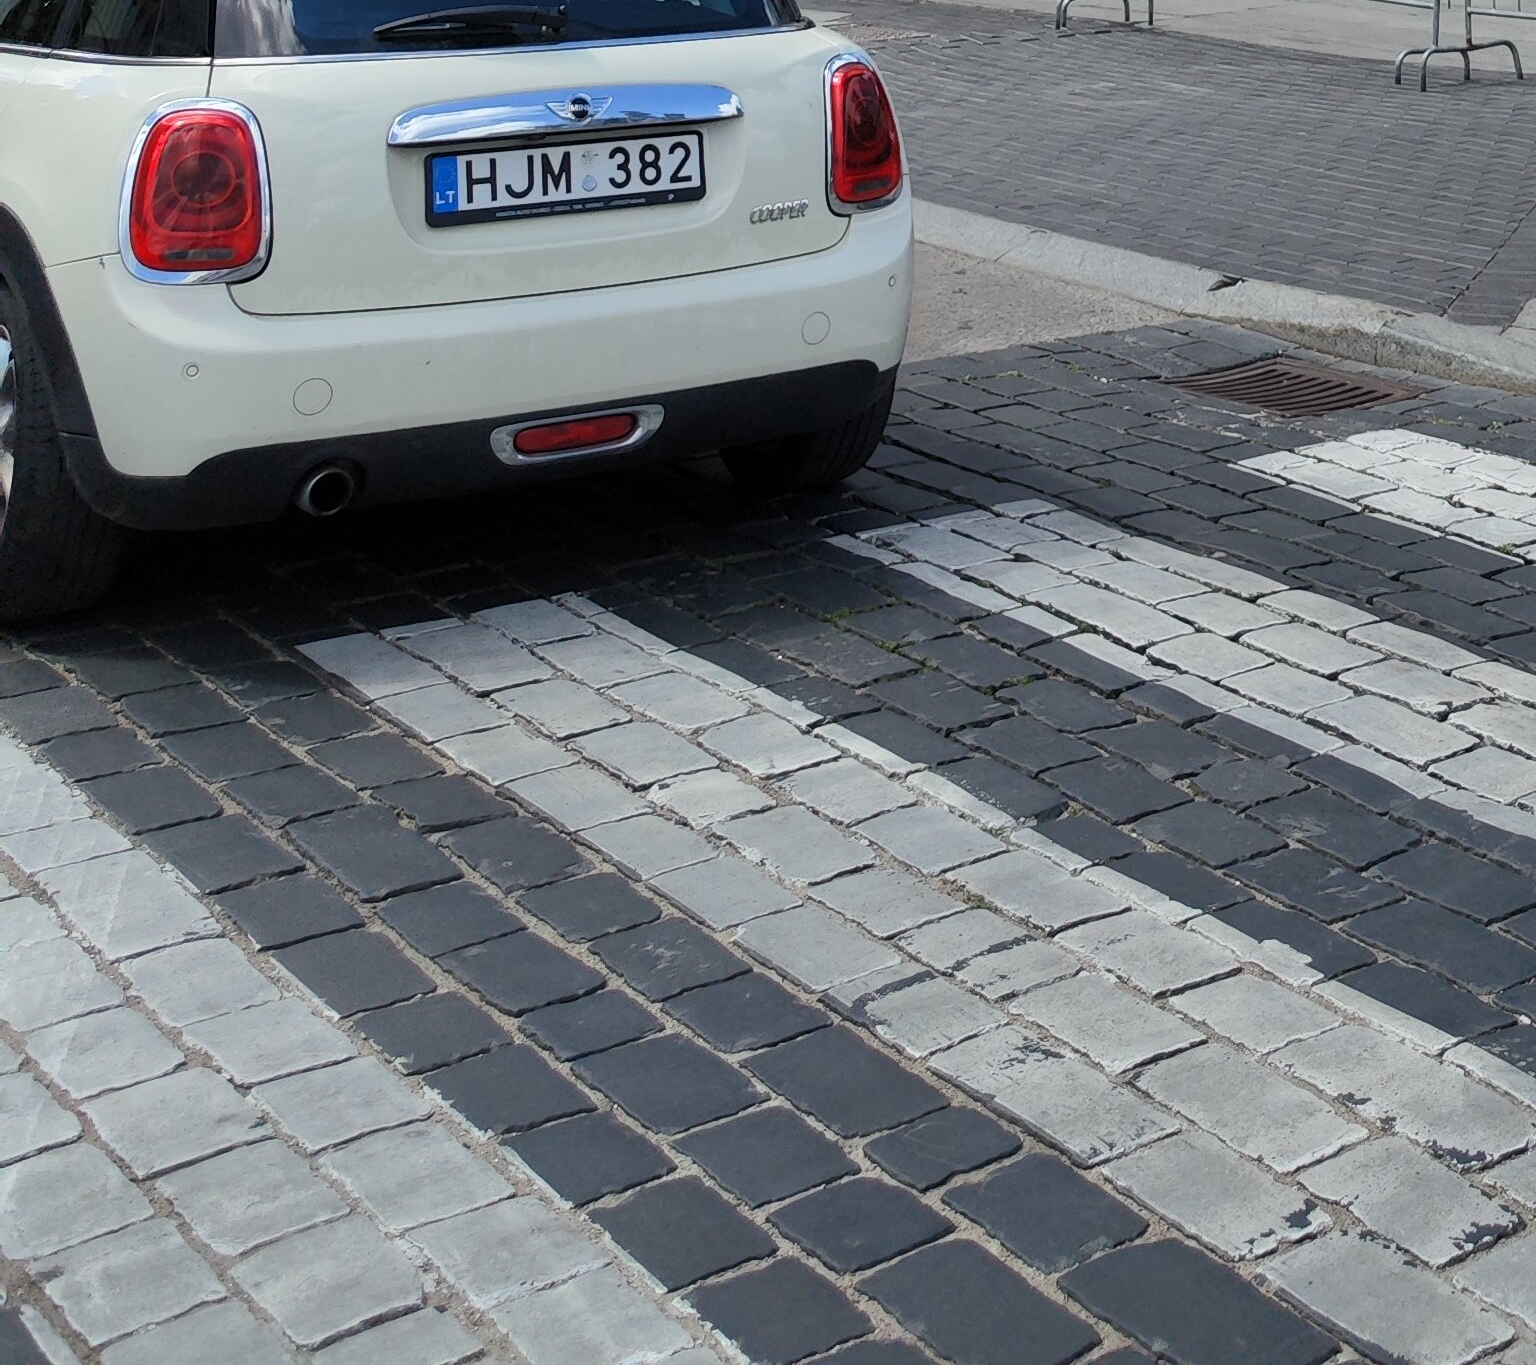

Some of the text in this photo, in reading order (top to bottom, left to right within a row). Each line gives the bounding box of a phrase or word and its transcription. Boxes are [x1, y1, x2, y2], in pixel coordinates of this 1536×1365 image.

[464, 138, 694, 205] HJM 382
[435, 190, 456, 205] LT
[749, 198, 809, 225] COOPER
